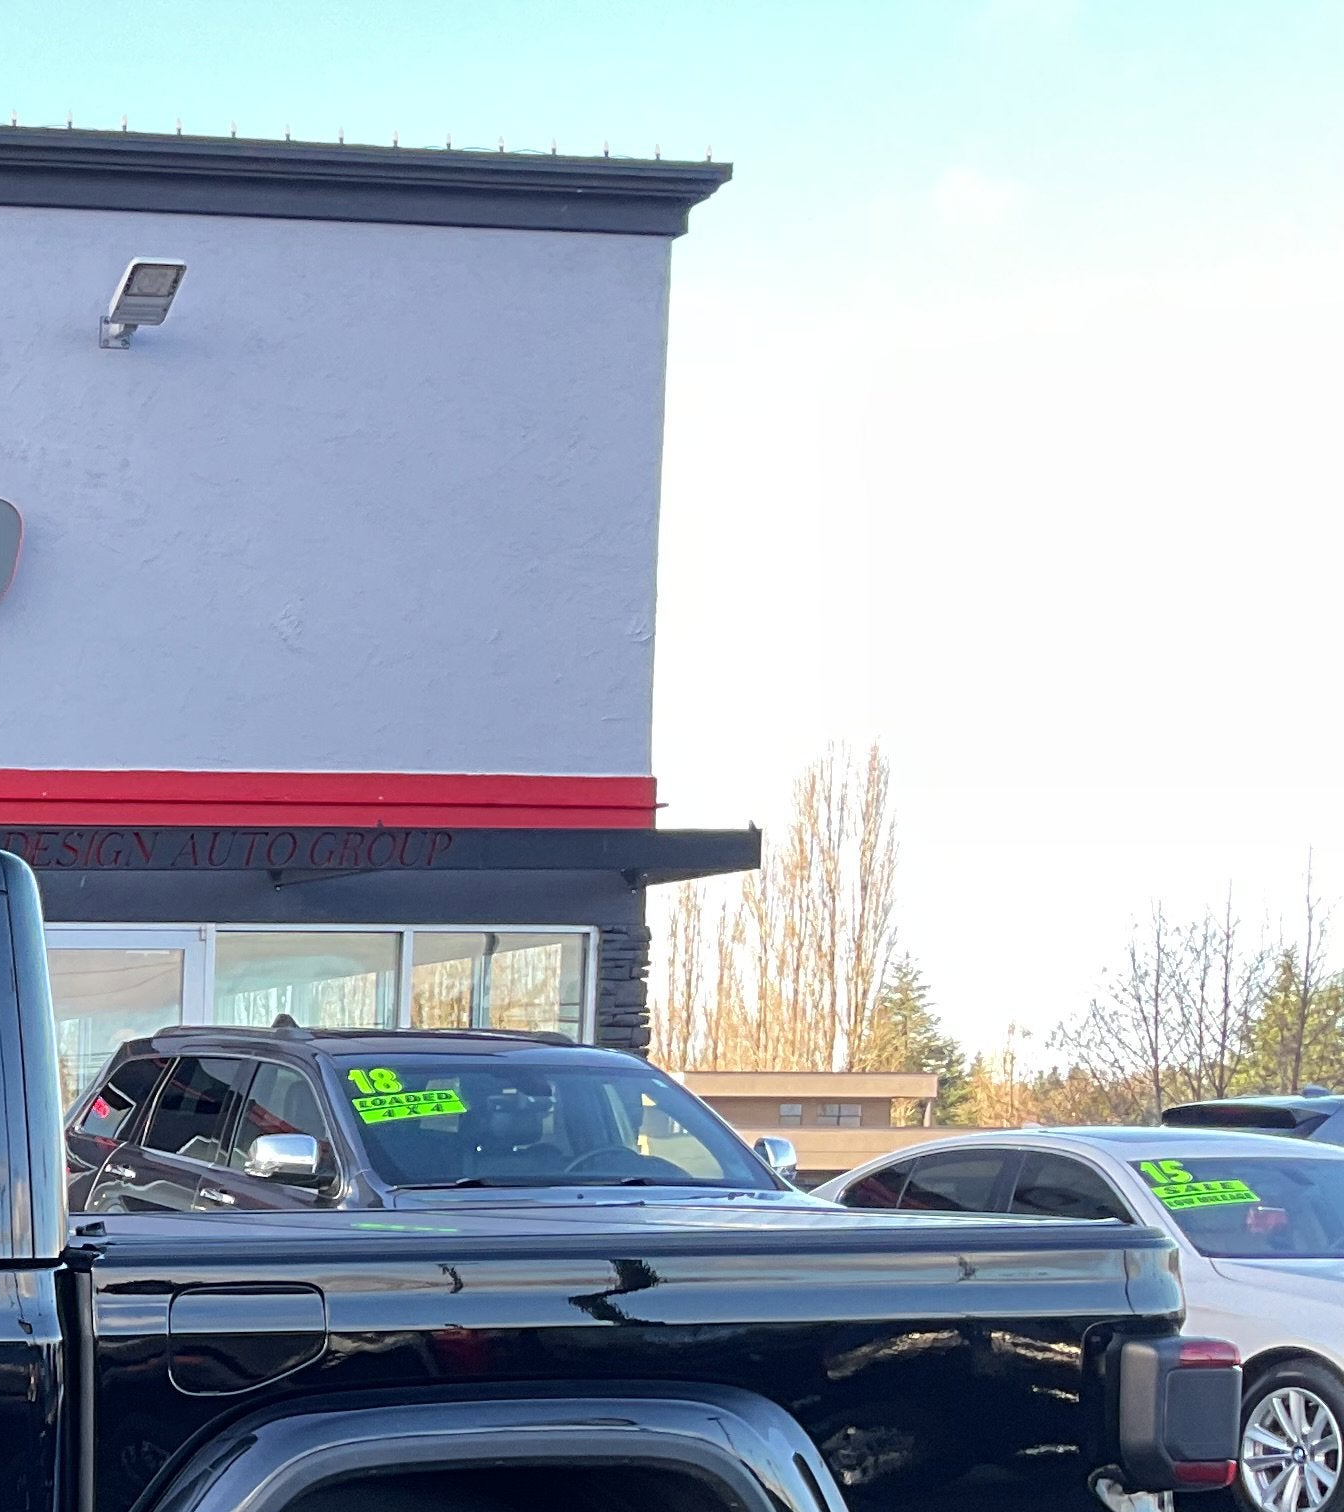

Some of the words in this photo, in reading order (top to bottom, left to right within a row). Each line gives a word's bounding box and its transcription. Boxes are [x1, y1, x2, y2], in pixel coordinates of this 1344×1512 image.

[170, 831, 298, 867] AUTO
[309, 831, 453, 867] GROUP
[347, 1067, 403, 1095] 18
[358, 1092, 453, 1109] LOADED
[1139, 1160, 1193, 1184] 15
[1163, 1181, 1234, 1195] SALE
